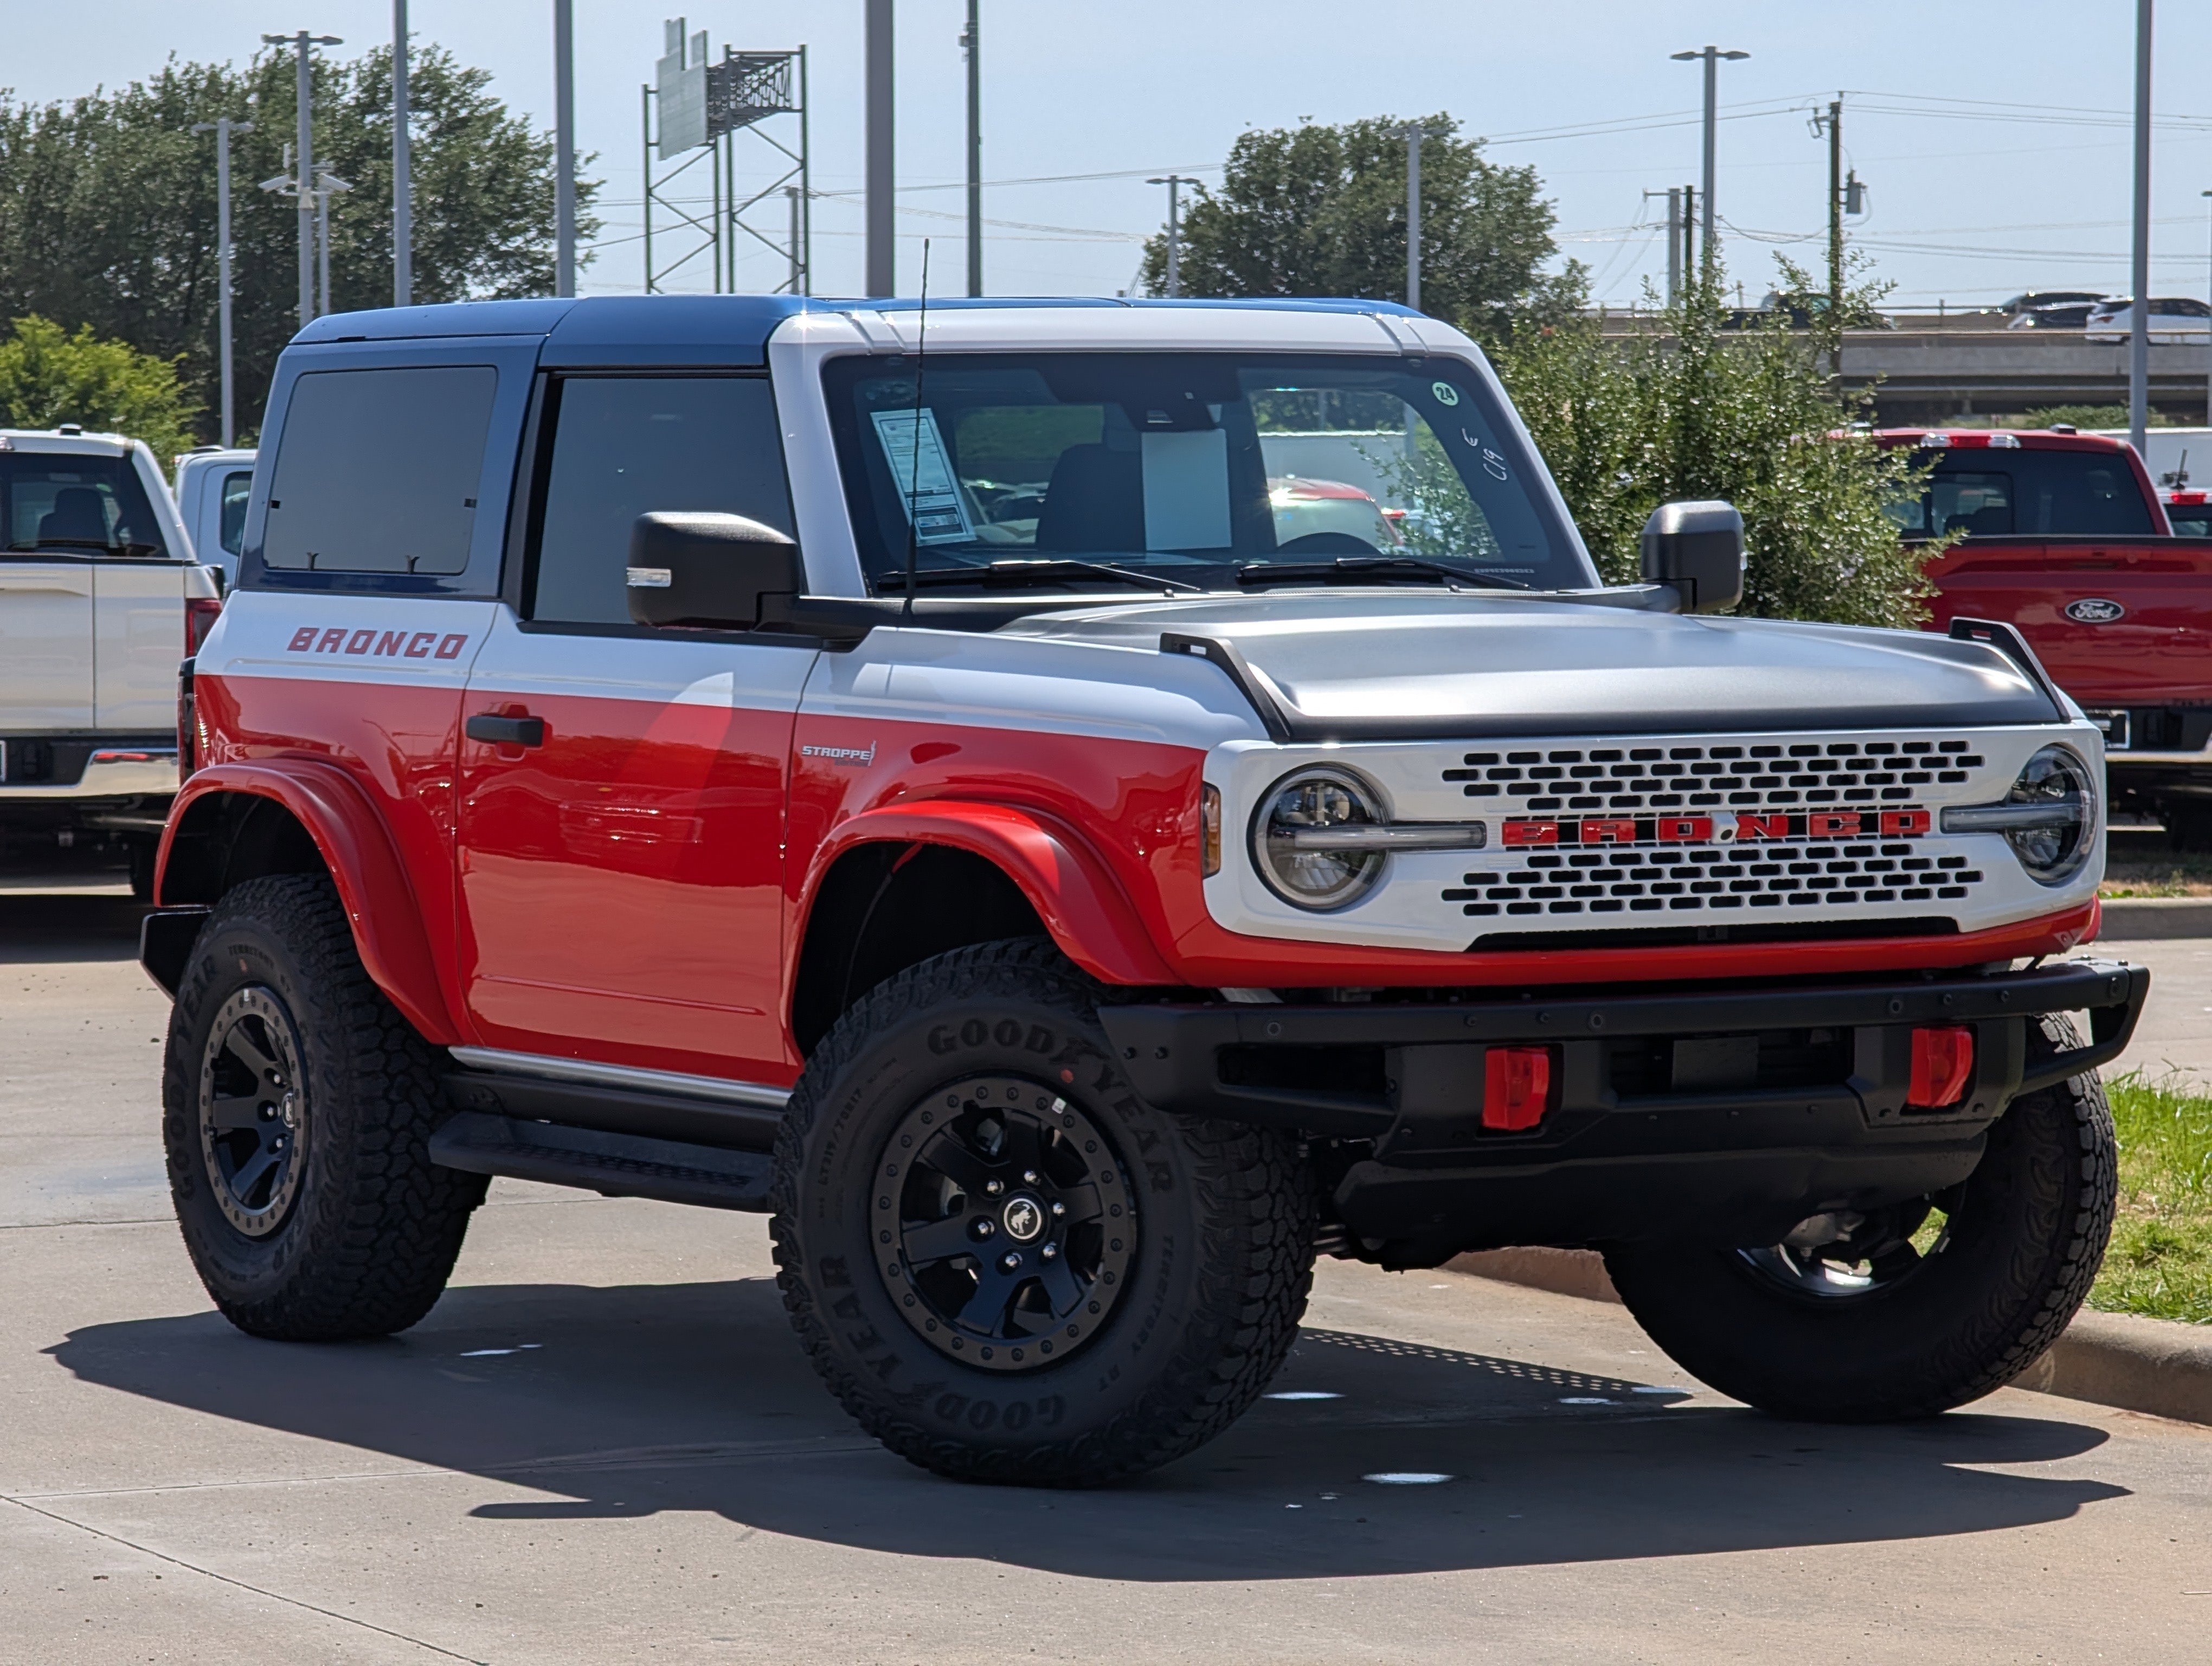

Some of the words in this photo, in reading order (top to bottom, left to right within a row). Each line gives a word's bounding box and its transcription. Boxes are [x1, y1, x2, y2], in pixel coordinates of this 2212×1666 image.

[1436, 387, 1455, 401] 24
[2074, 602, 2114, 618] Ford
[287, 627, 468, 659] BRONCO
[802, 745, 871, 760] STROPPE
[1502, 810, 1930, 845] BRONCO
